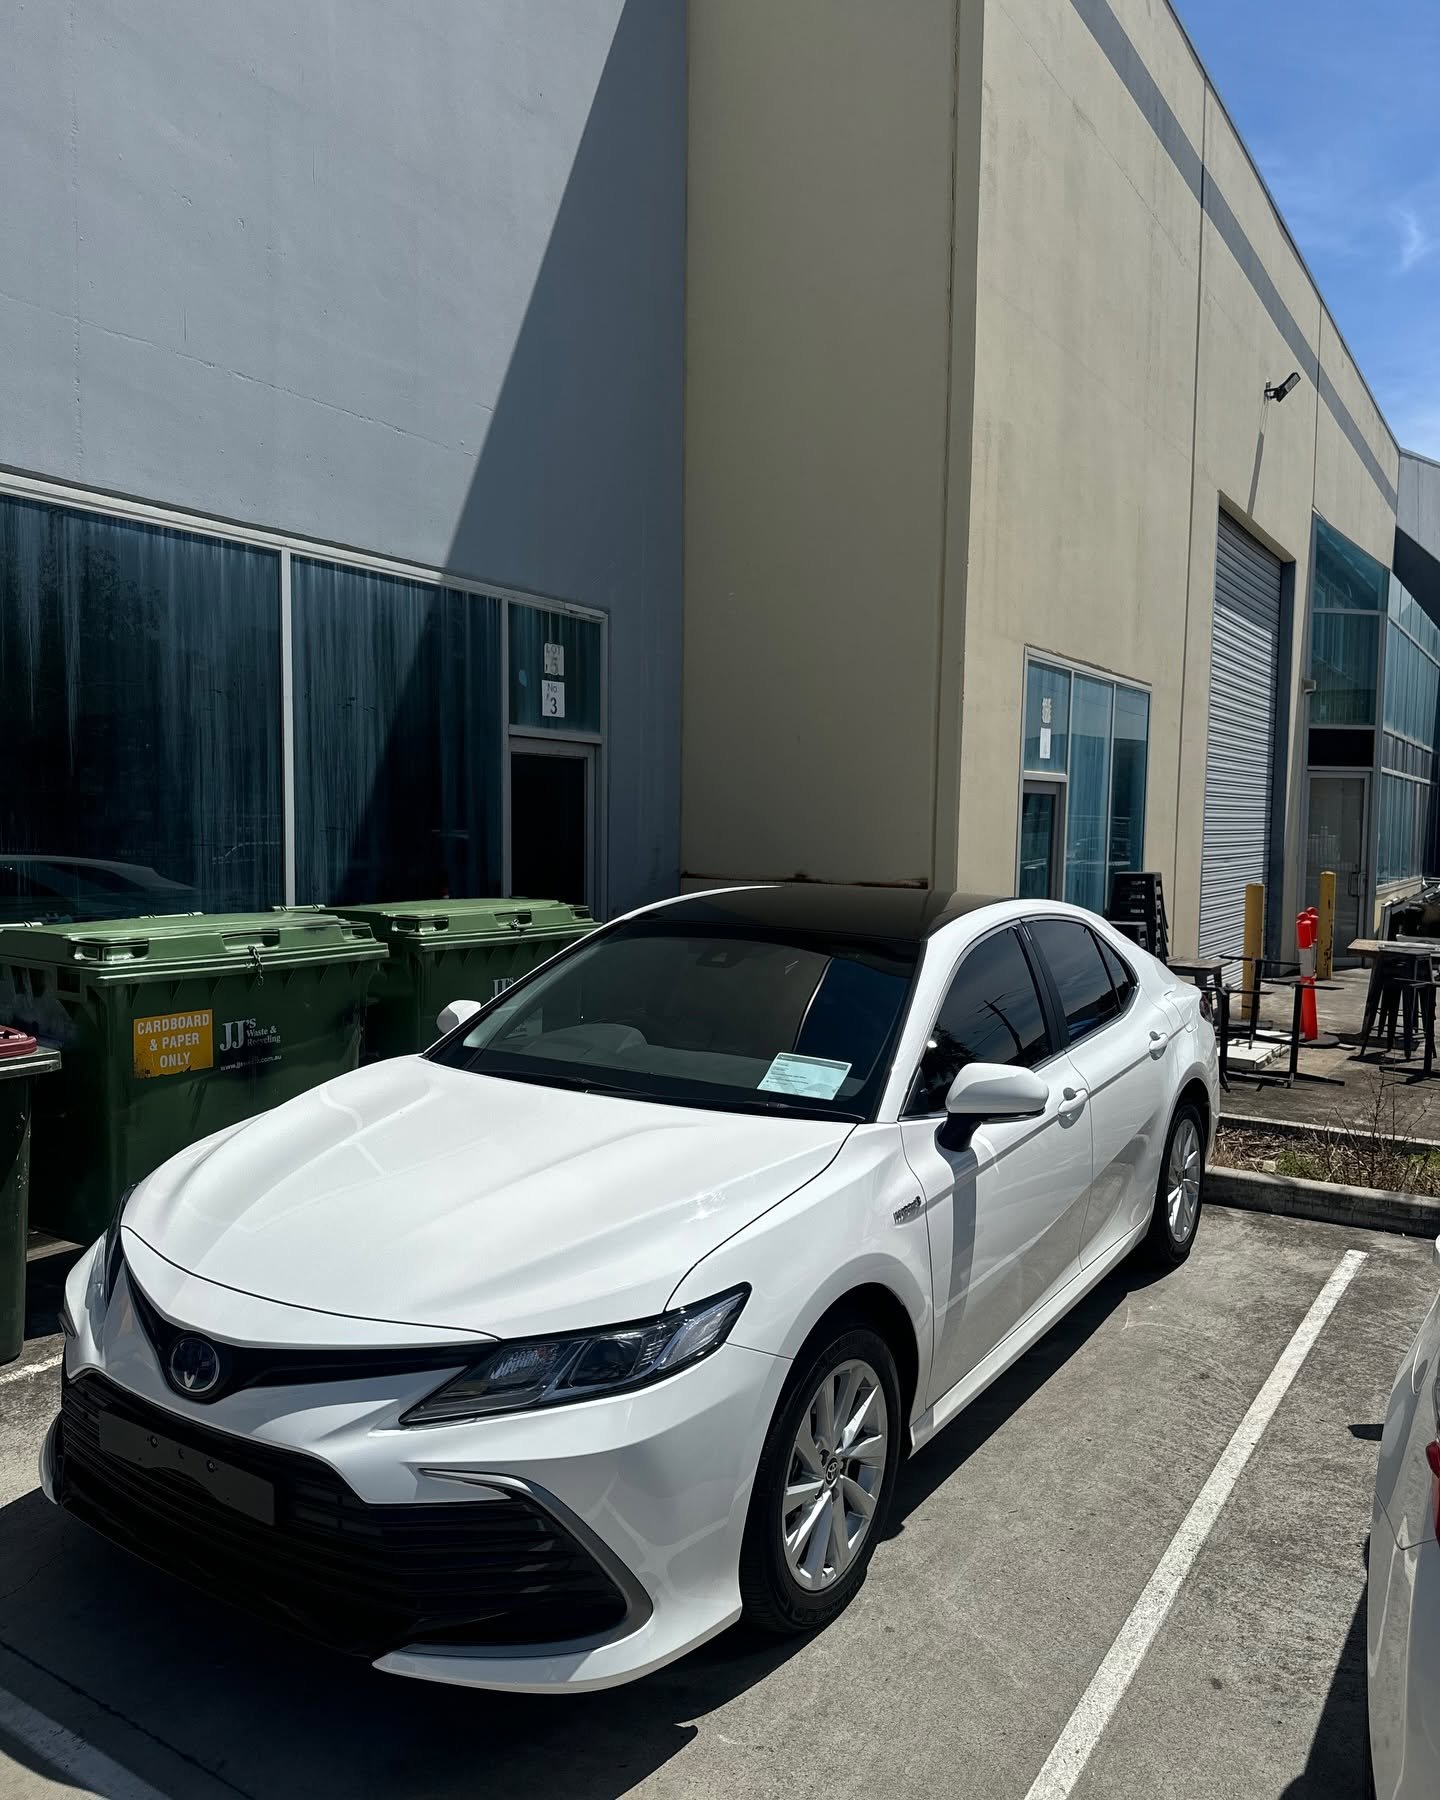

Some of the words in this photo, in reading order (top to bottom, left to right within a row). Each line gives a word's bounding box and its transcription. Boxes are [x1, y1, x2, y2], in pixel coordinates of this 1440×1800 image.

[550, 697, 558, 714] 3
[137, 1014, 209, 1035] CARDBOARD
[246, 1028, 268, 1037] Waste
[270, 1025, 277, 1034] &
[149, 1039, 158, 1051] &
[162, 1032, 200, 1049] PAPER
[247, 1035, 281, 1047] Recycling
[160, 1051, 190, 1068] ONLY
